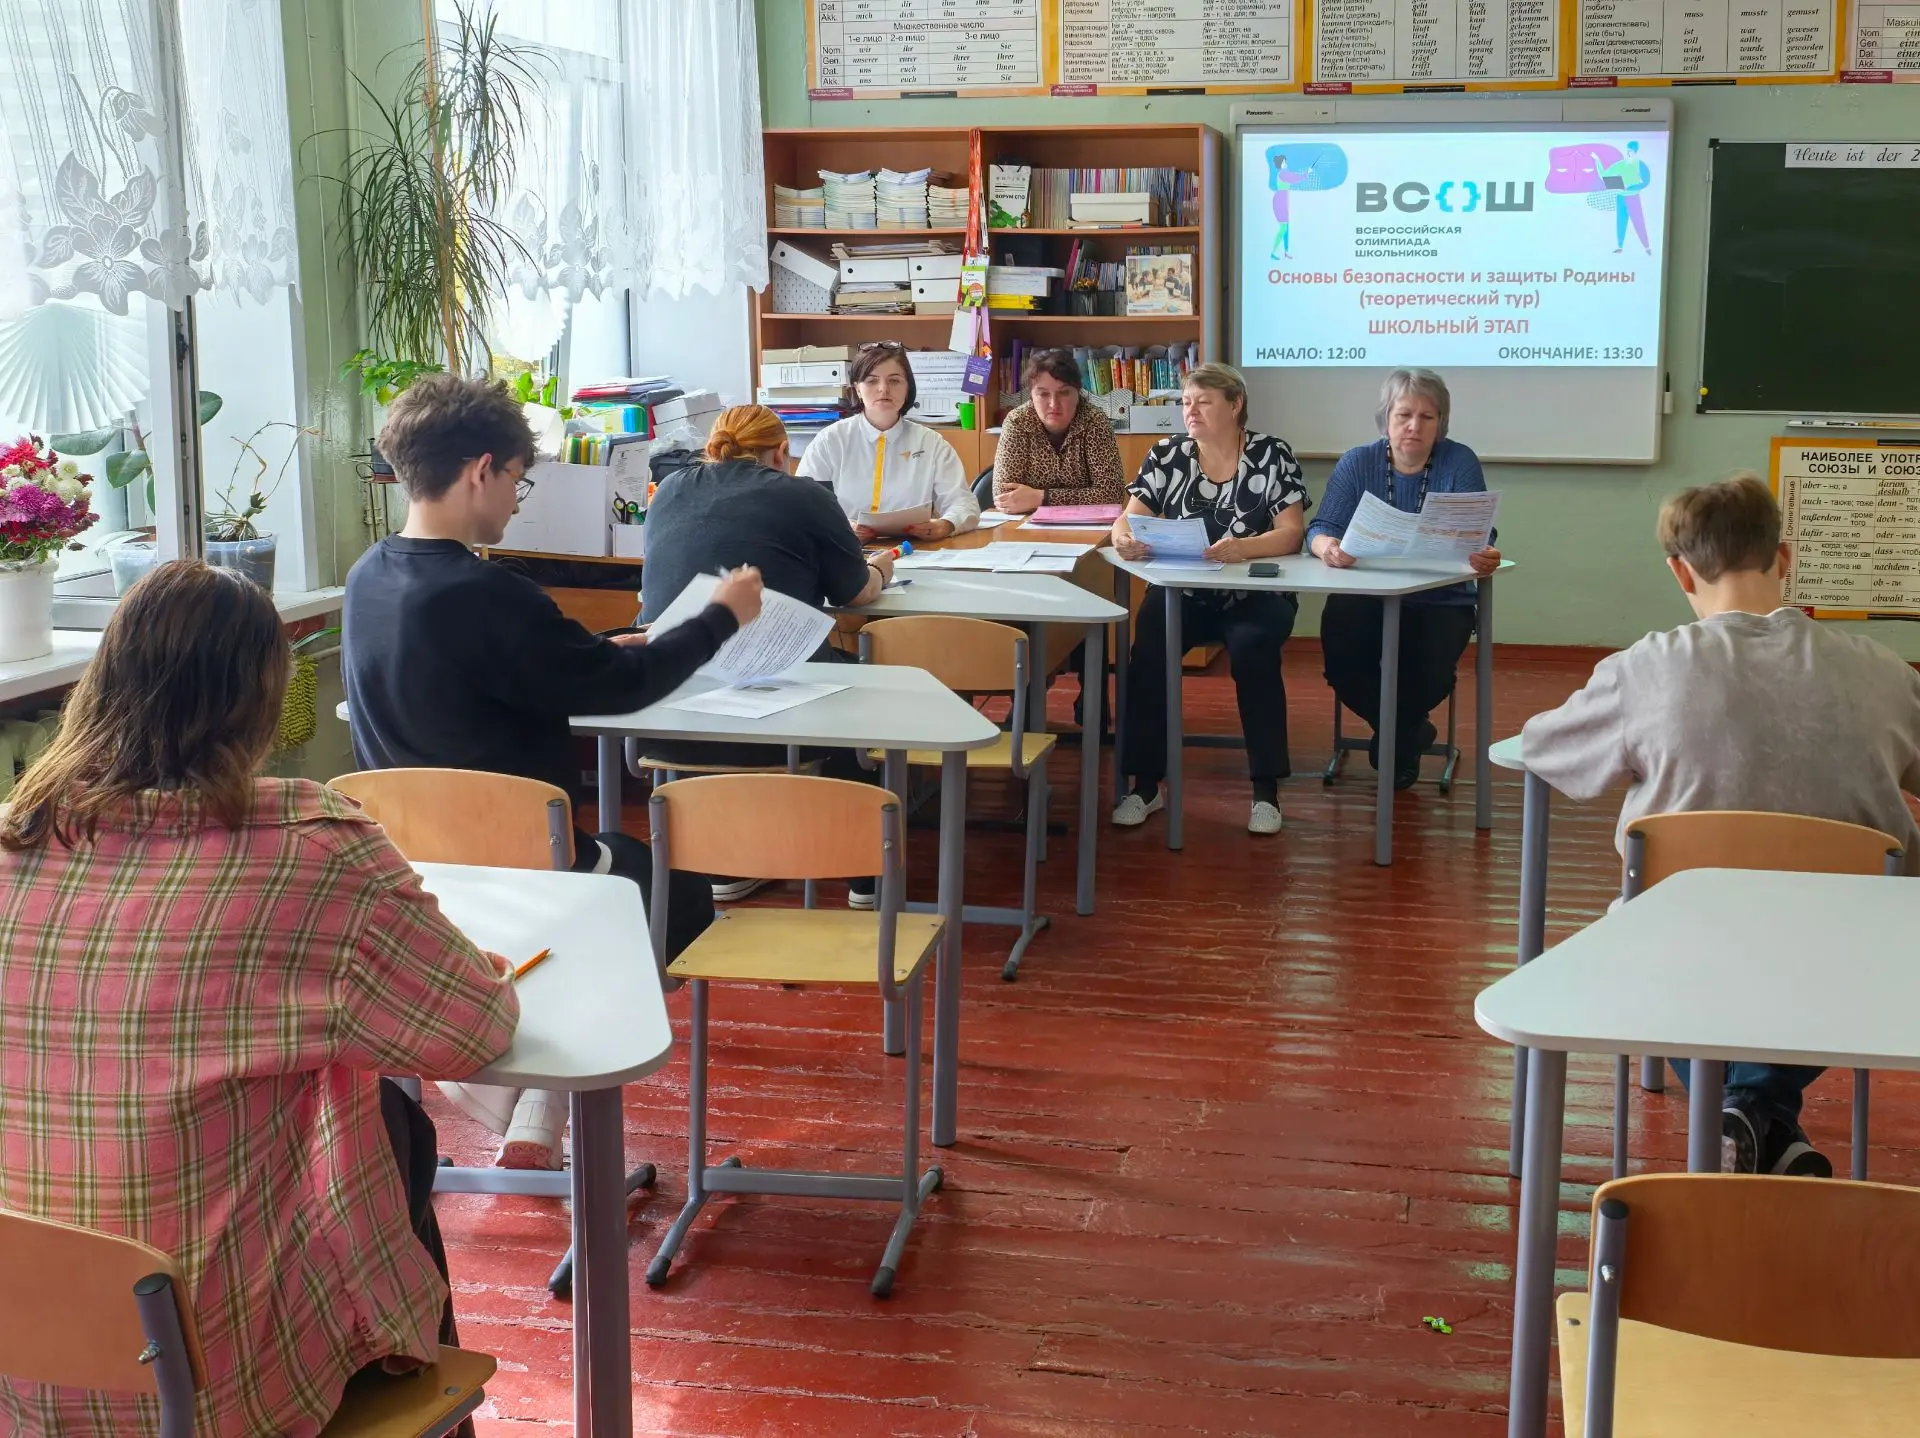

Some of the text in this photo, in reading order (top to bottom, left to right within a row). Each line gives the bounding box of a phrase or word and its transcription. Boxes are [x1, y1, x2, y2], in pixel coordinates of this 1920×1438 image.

[960, 21, 985, 29] число
[1793, 147, 1838, 162] Heute
[1846, 148, 1865, 162] ist
[1876, 148, 1902, 162] der
[1355, 225, 1462, 235] ВСЕРОССИЙСКАЯ
[1355, 238, 1431, 246] ОЛИМПИАДА
[1355, 249, 1438, 257] ШКОЛЬНИКОВ
[1268, 268, 1635, 286] Основы безопасности и защиты Родины
[1360, 289, 1540, 310] (теоретический тур)
[1368, 316, 1530, 334] ШКОЛЬНЫЙ ЭТАП
[1256, 347, 1366, 360] НАЧАЛО: 12:00
[1498, 346, 1644, 360] ОКОНЧАНИЕ: 13:30
[1801, 452, 1873, 462] НАИБОЛЕЕ
[1808, 464, 1860, 474] СОЮЗЫ
[1868, 465, 1877, 474] И
[1802, 481, 1822, 489] aber
[1878, 488, 1910, 496] deshalb
[1801, 497, 1822, 505] auch
[1801, 513, 1841, 522] außerdem
[1800, 528, 1823, 537] dafür
[1876, 530, 1894, 539] oder
[1799, 545, 1813, 553] als
[1874, 546, 1893, 555] dass
[1873, 562, 1910, 571] nachdem
[1798, 576, 1823, 585] damit
[1873, 579, 1884, 587] ob
[1797, 591, 1812, 600] das
[1872, 594, 1904, 603] obwohl
